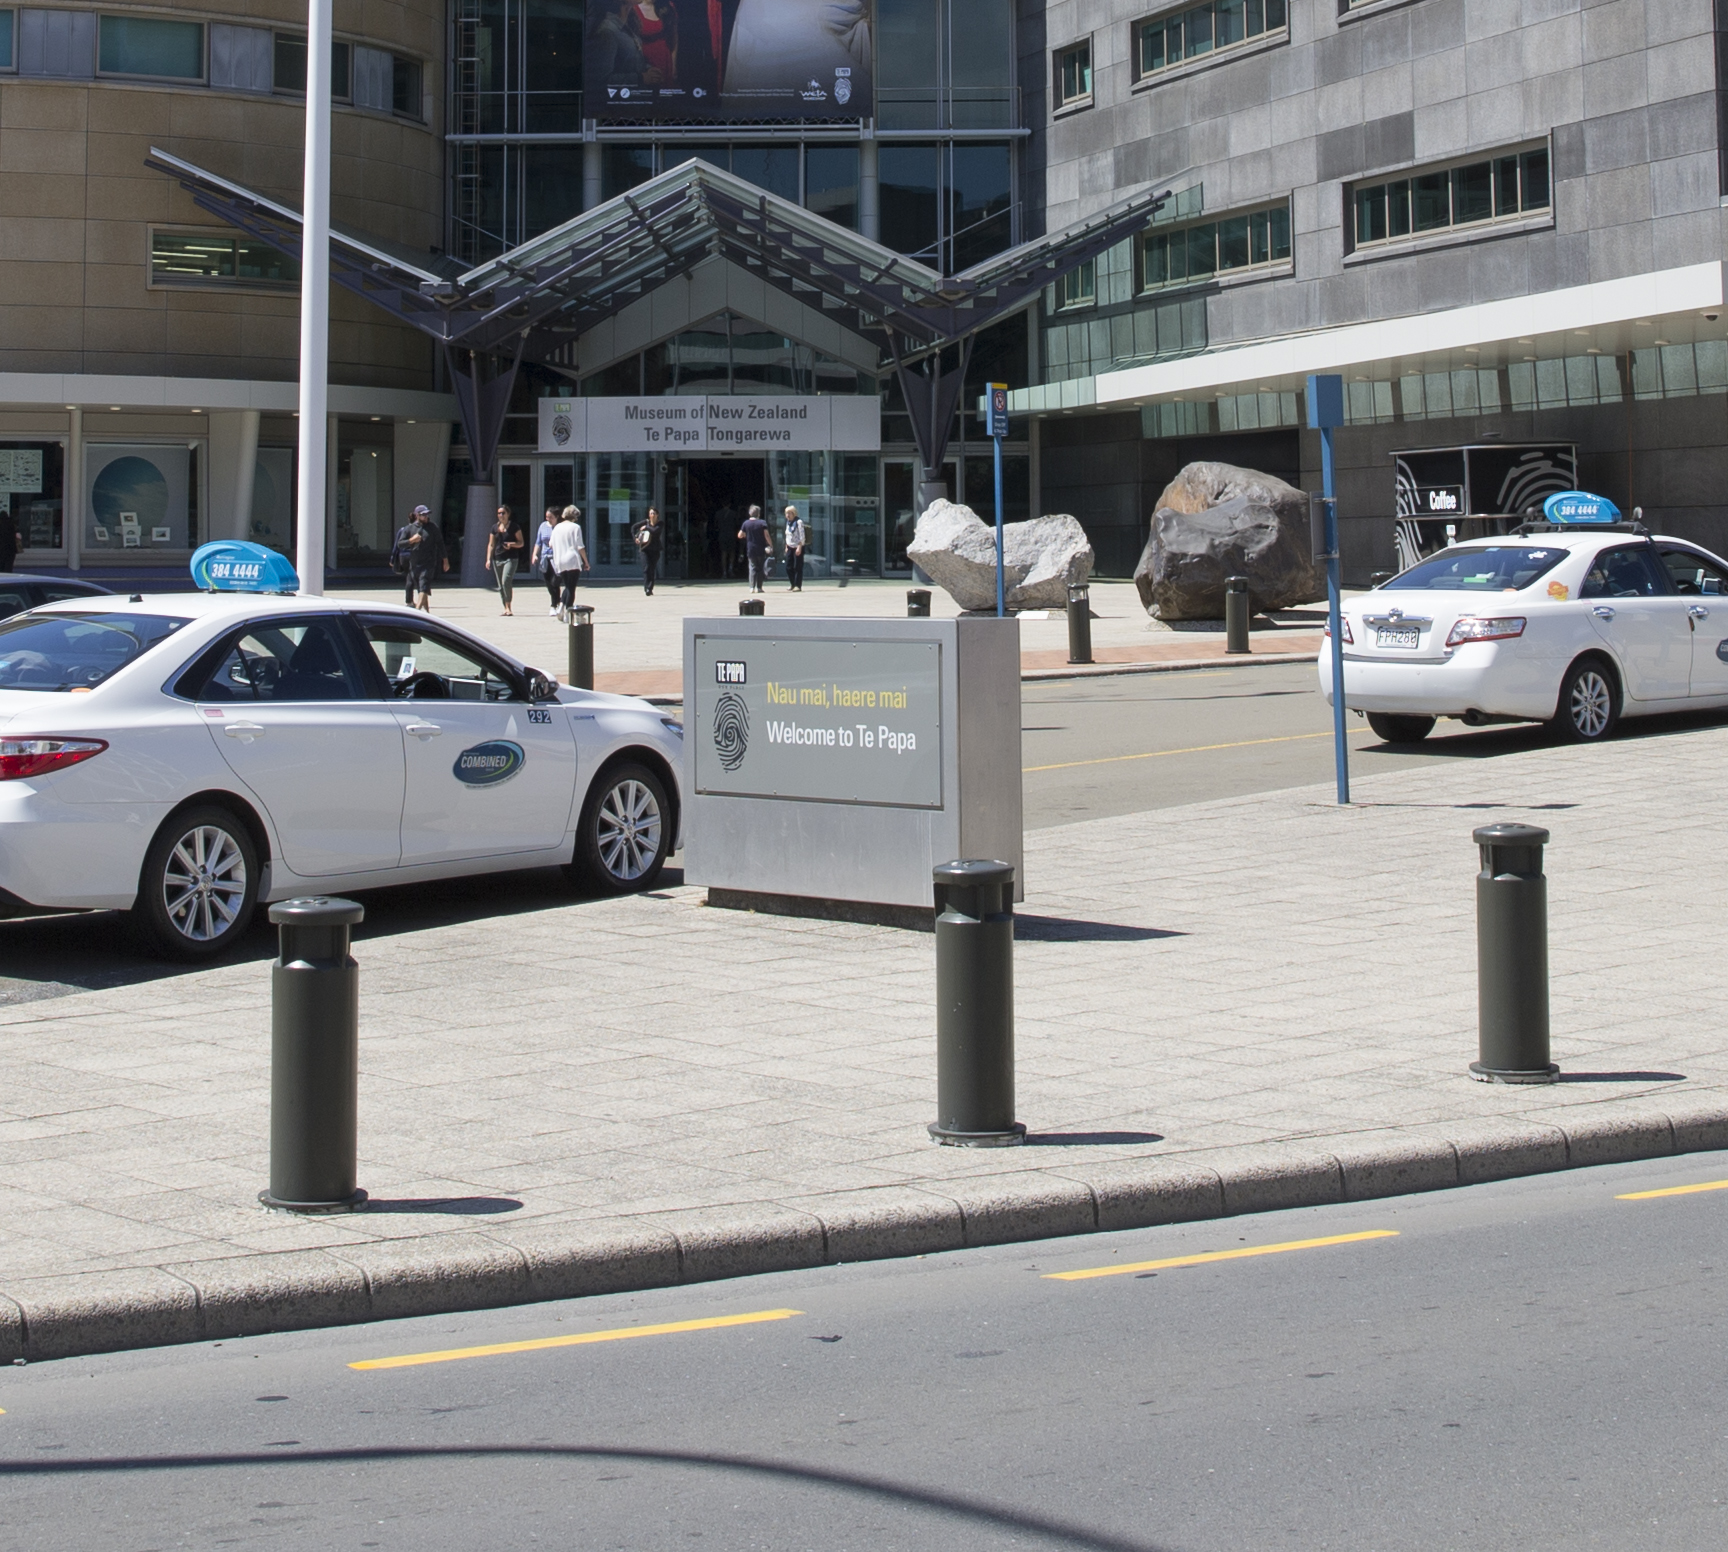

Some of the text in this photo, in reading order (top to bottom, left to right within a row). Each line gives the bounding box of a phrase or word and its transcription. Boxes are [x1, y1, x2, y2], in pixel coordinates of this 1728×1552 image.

[625, 404, 808, 420] Museum of New Zealand
[643, 426, 791, 446] Te Papa Tongarewa
[1429, 490, 1457, 510] Coffee
[1560, 505, 1597, 515] 384 4444
[212, 563, 259, 578] 384 4444
[1378, 630, 1417, 643] FPH280
[716, 663, 745, 683] TE PAPA
[767, 682, 907, 709] Nau mai, haere mai
[529, 711, 550, 723] 292
[766, 720, 916, 754] Welcome to Te Papa
[460, 755, 506, 768] COMBINED
